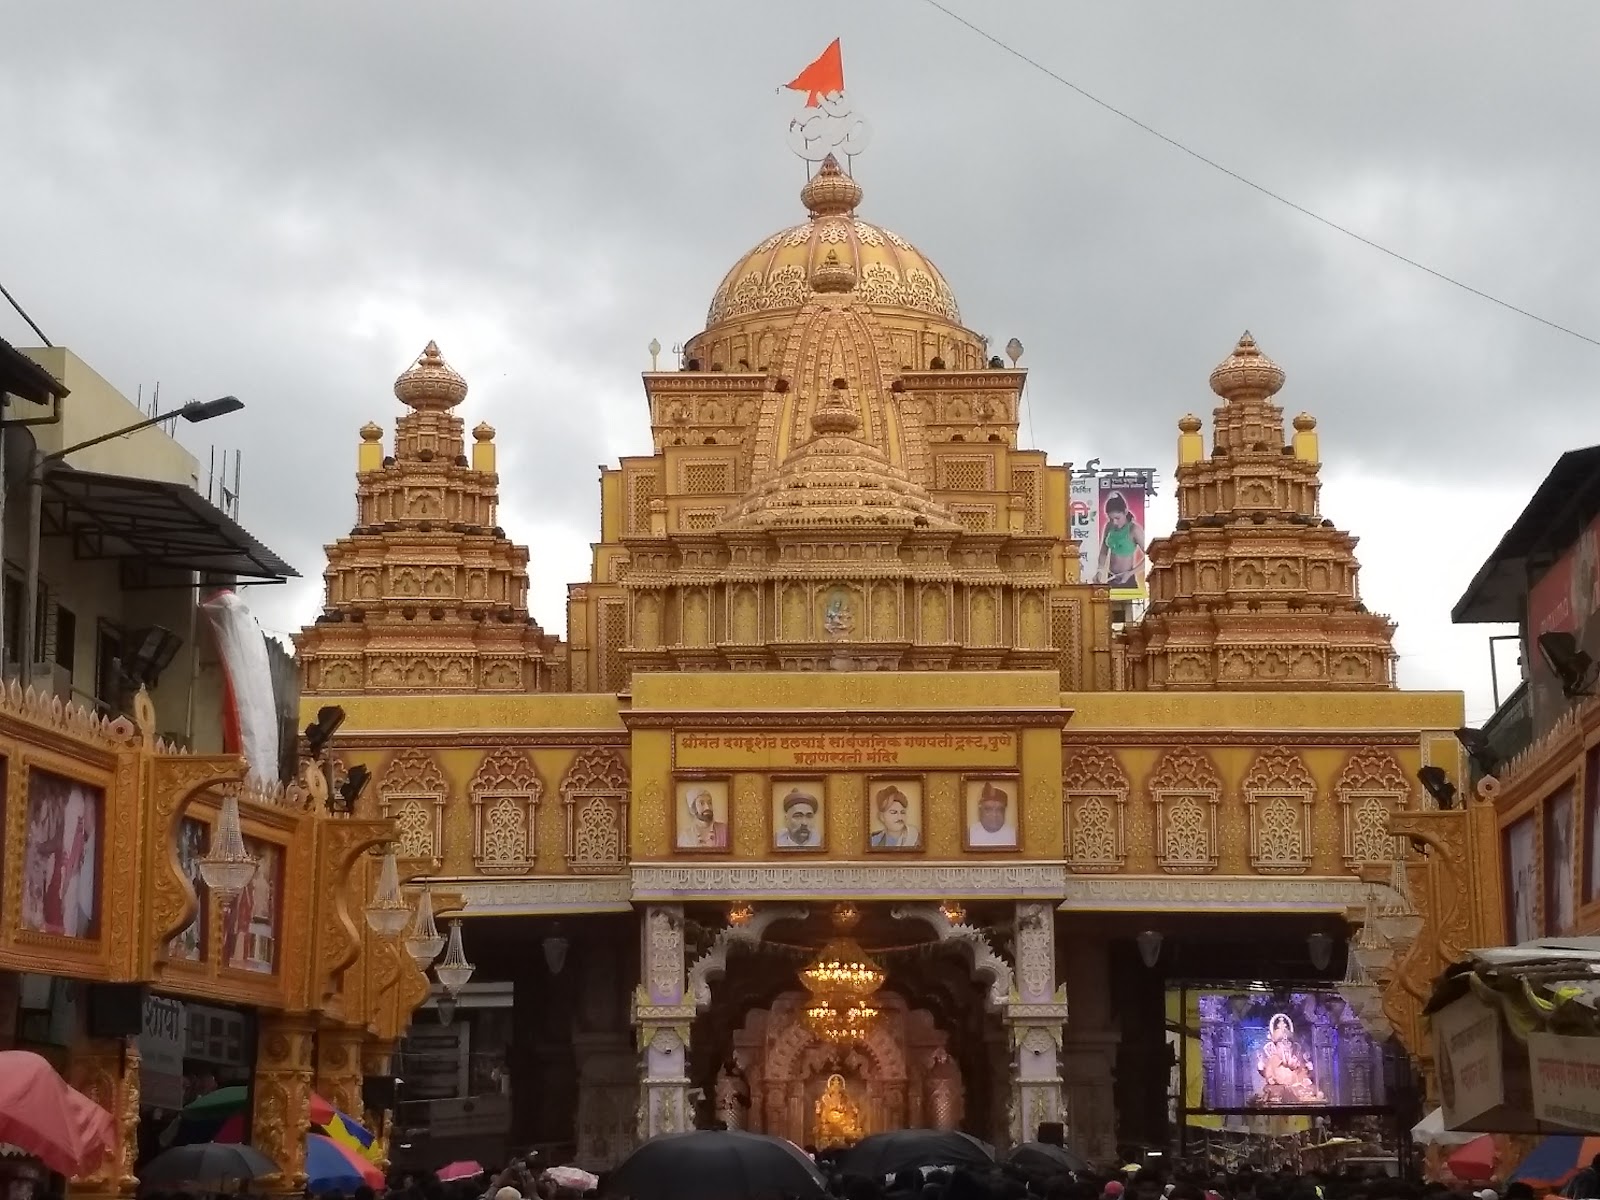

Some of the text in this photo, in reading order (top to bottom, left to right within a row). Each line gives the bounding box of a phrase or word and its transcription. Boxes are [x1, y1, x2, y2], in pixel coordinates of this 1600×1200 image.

[681, 733, 720, 748] श्रीमंत
[723, 732, 777, 754] दगडूशेठ
[779, 732, 825, 750] हलवाई
[828, 732, 901, 748] सार्वजनिक
[903, 732, 953, 748] गणपती
[988, 732, 1012, 752] पुणे
[866, 748, 899, 764] मंदिर
